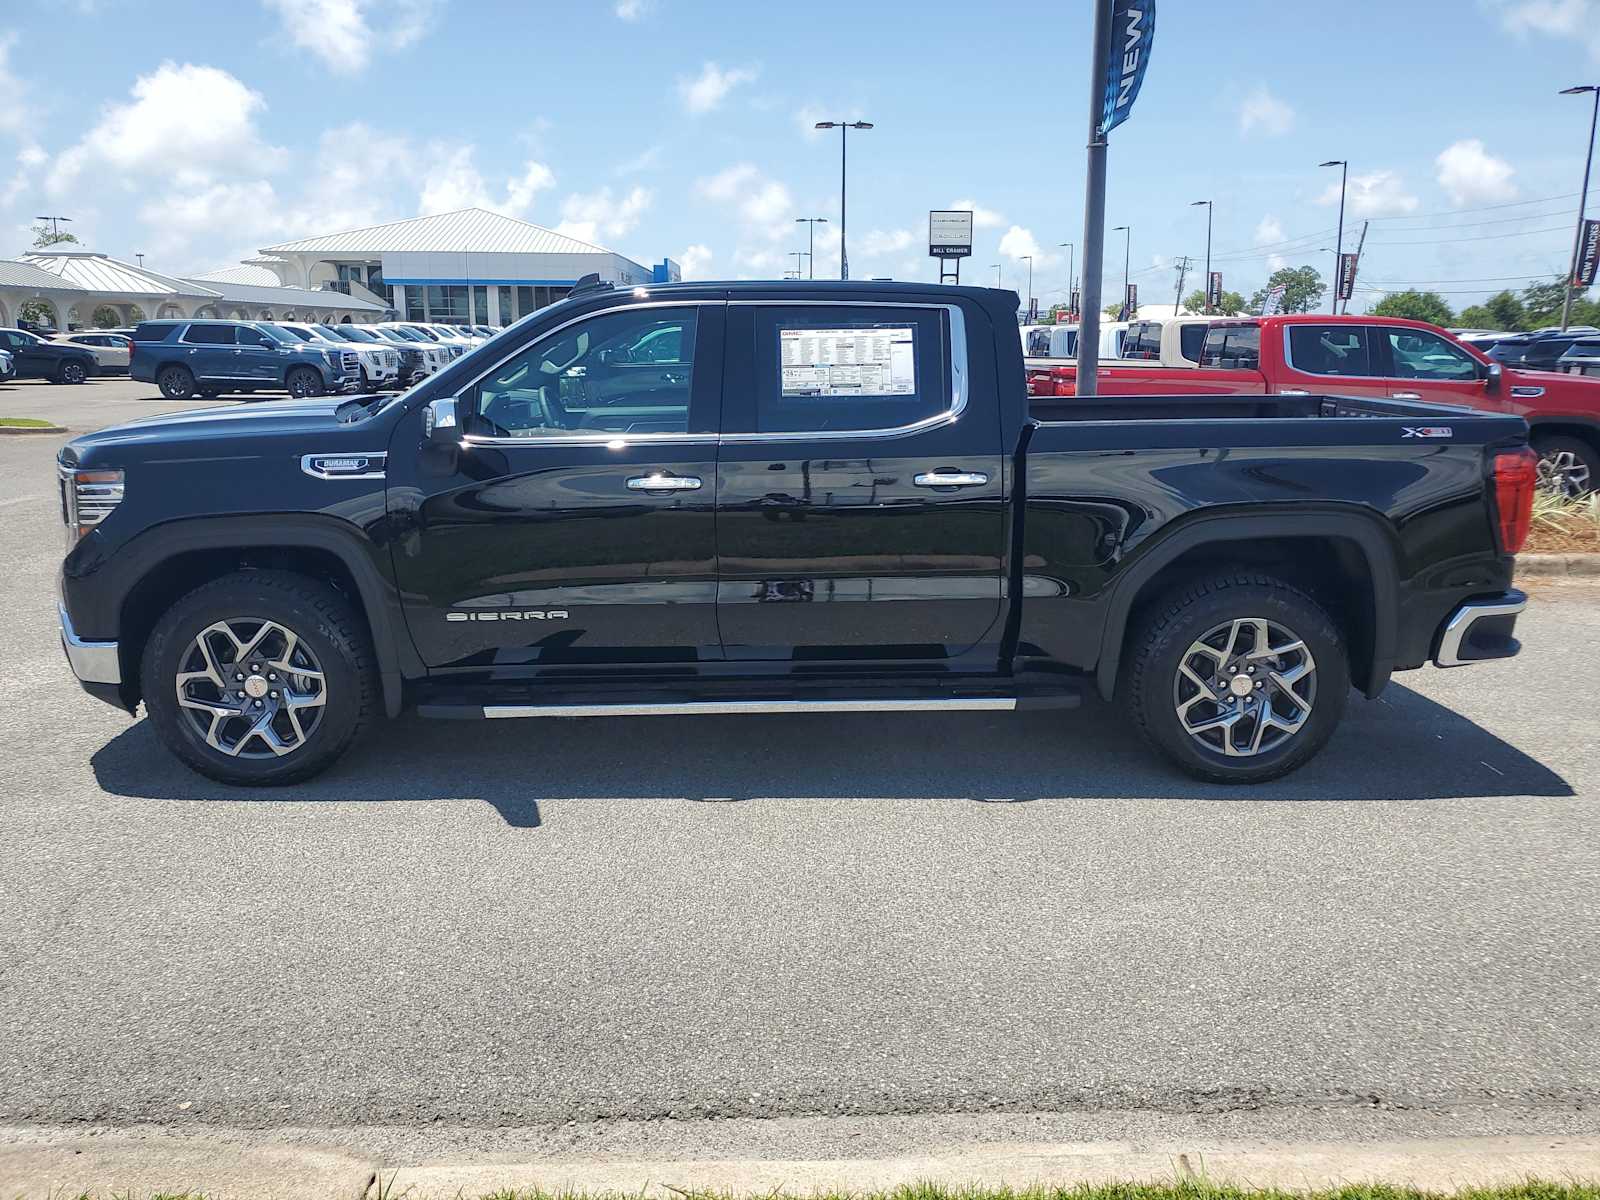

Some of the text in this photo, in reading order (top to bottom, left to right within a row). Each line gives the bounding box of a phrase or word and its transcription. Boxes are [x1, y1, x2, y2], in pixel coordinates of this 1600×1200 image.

[1116, 9, 1143, 109] NEW
[1581, 224, 1599, 282] NEW TRUCKS
[446, 610, 569, 622] SIERRA
